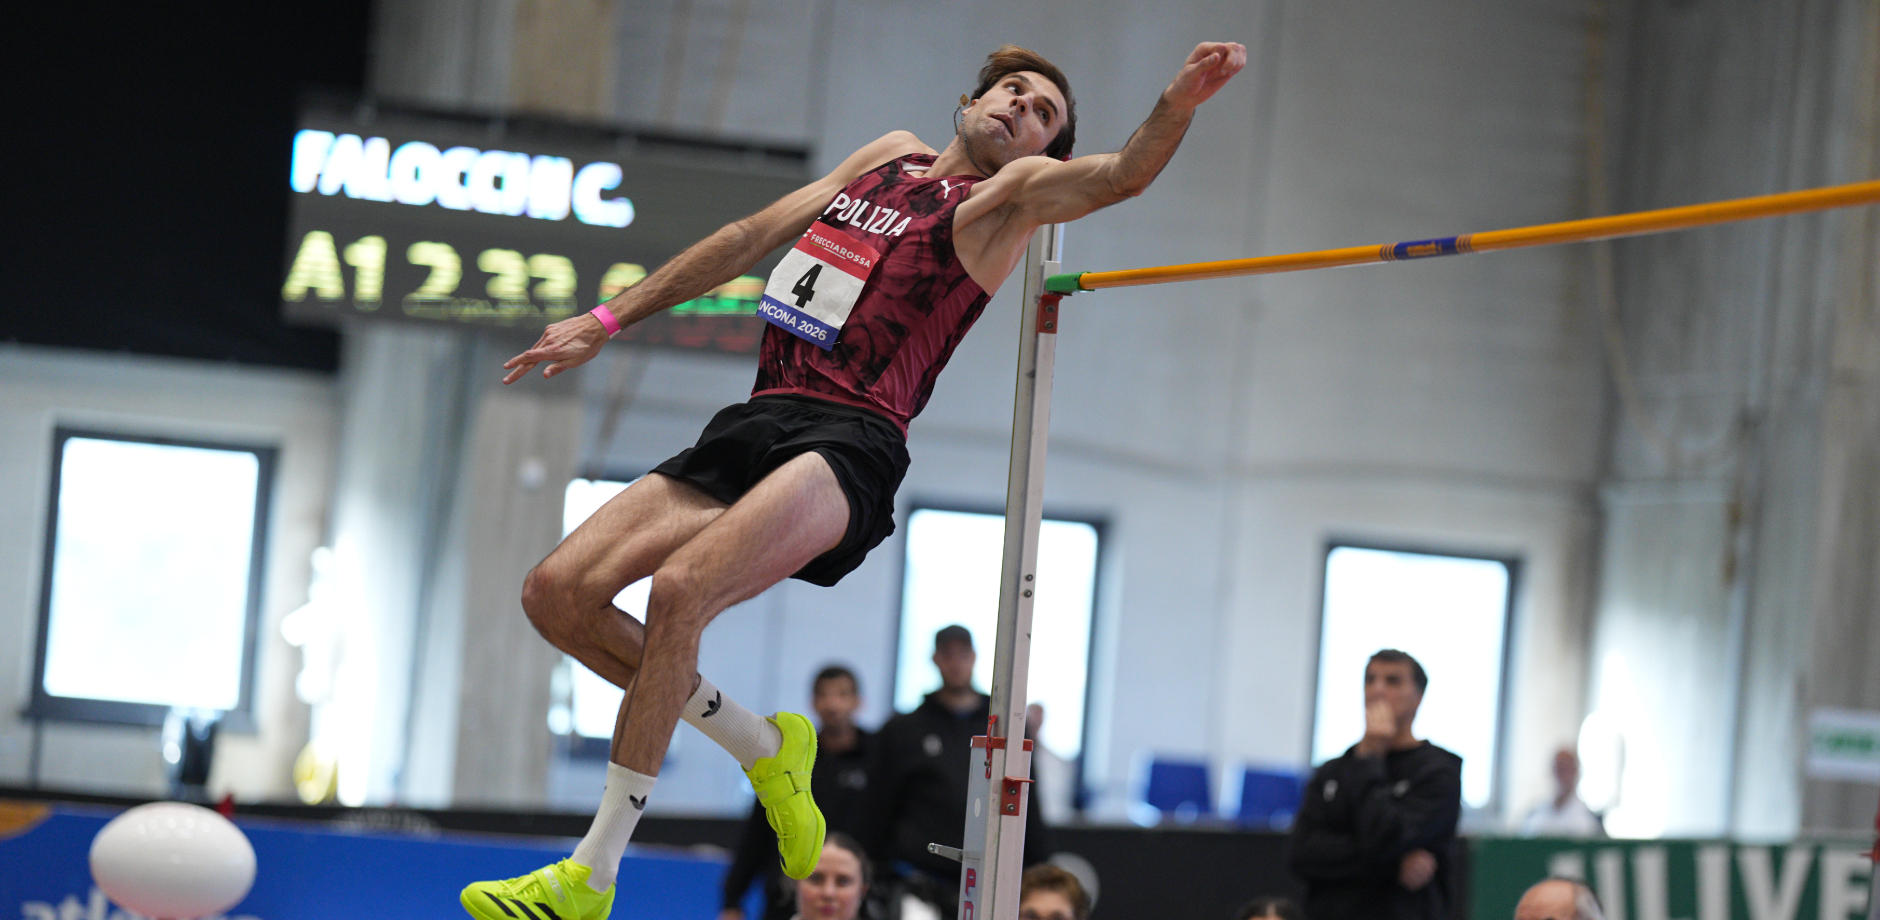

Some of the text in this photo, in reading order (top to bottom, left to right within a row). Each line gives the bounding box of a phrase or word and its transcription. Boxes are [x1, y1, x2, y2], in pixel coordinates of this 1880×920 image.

[822, 192, 912, 237] POLIZIA
[282, 230, 388, 311] A1
[810, 233, 871, 268] FRECCIAROSSA
[791, 263, 823, 309] 4
[797, 320, 828, 341] 2026
